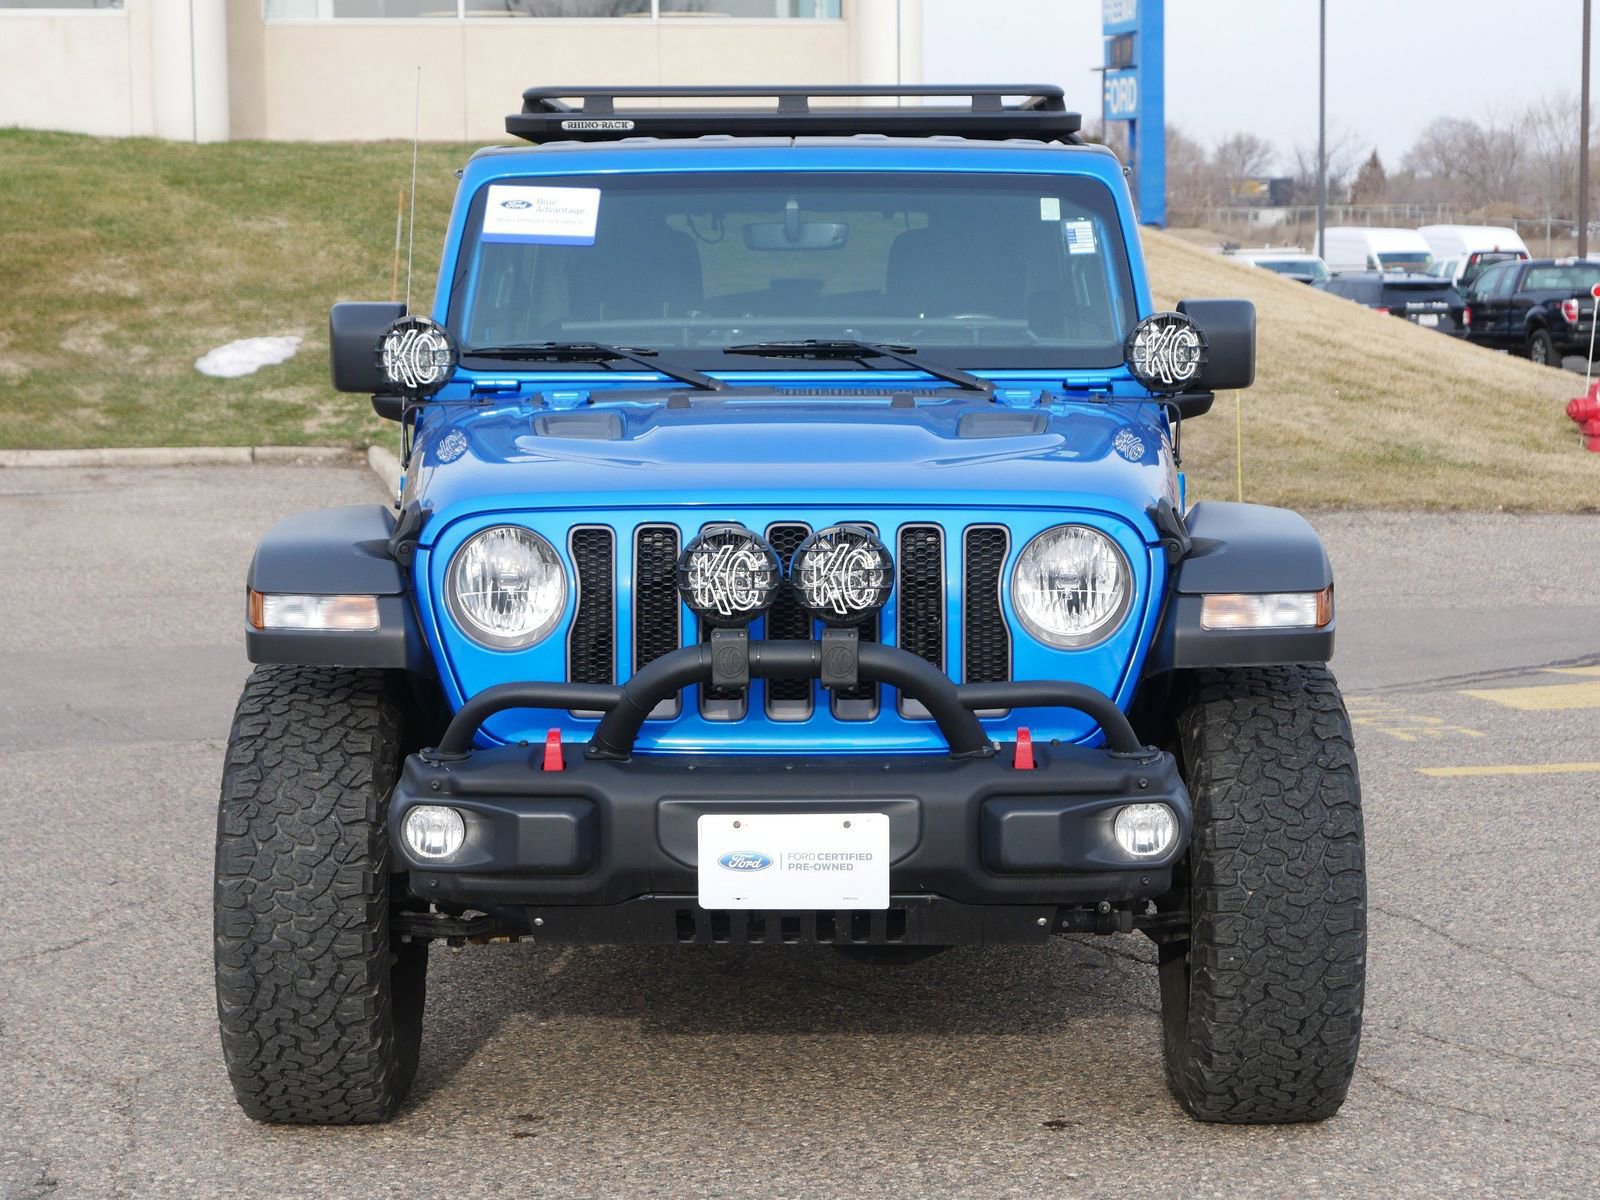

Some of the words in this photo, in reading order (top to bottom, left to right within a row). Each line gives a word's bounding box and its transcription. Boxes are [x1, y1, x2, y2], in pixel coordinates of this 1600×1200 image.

[567, 121, 629, 129] RHINO-RACK
[535, 206, 586, 216] Advantage
[388, 329, 438, 388] KC
[1145, 325, 1195, 383] KC
[698, 544, 759, 615] KC
[813, 543, 875, 614] KC
[728, 854, 762, 869] Ford
[787, 852, 816, 861] FORD
[817, 852, 873, 861] CERTIFIED
[787, 862, 854, 871] PRE-OWNED
